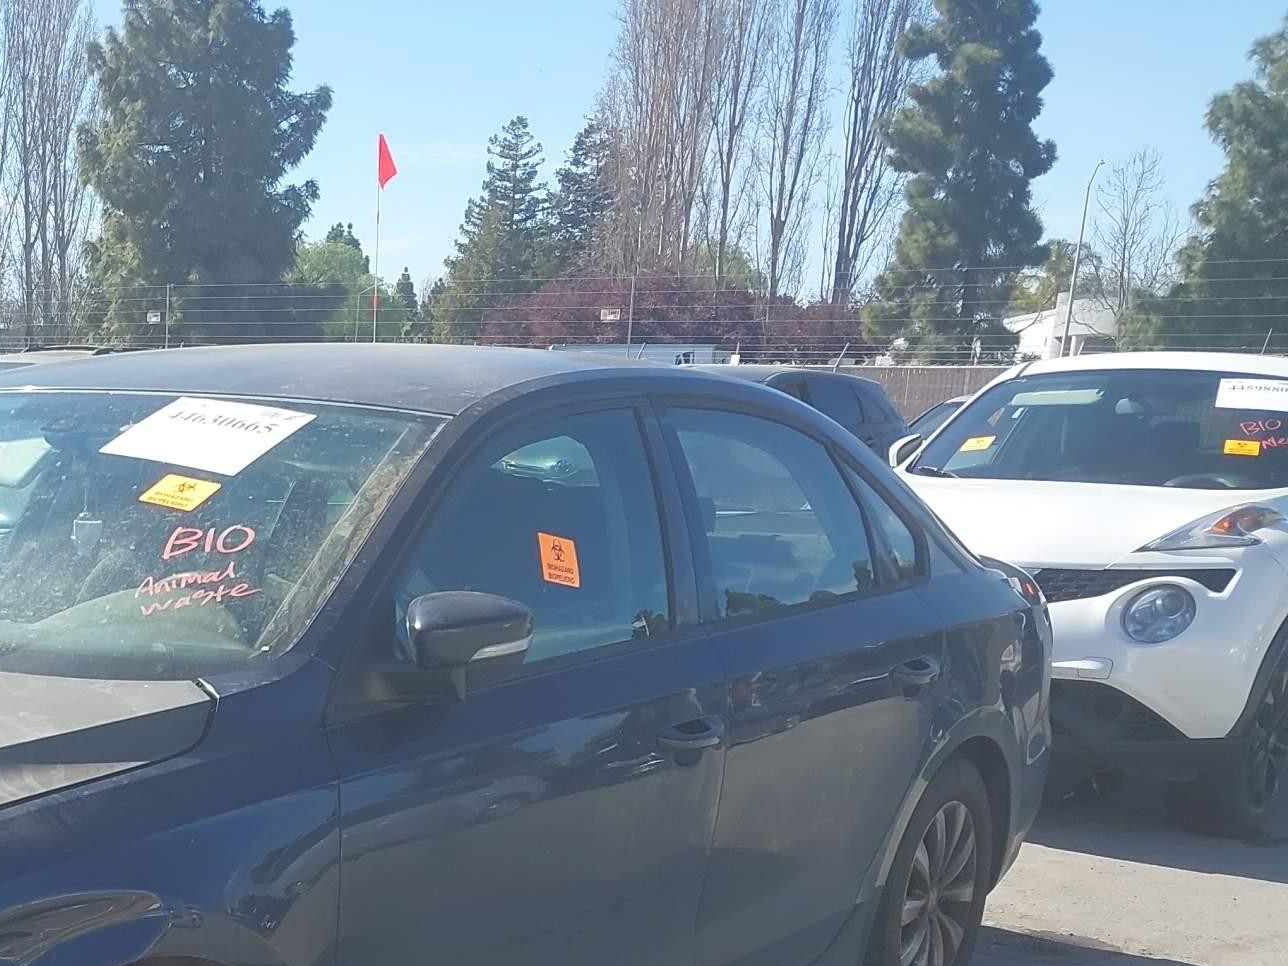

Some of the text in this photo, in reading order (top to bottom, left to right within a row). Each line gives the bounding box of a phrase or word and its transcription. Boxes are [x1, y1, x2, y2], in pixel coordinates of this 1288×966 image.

[168, 410, 279, 434] 44630665
[1239, 418, 1282, 436] BIO
[162, 524, 256, 560] BIO
[134, 561, 236, 598] Animal
